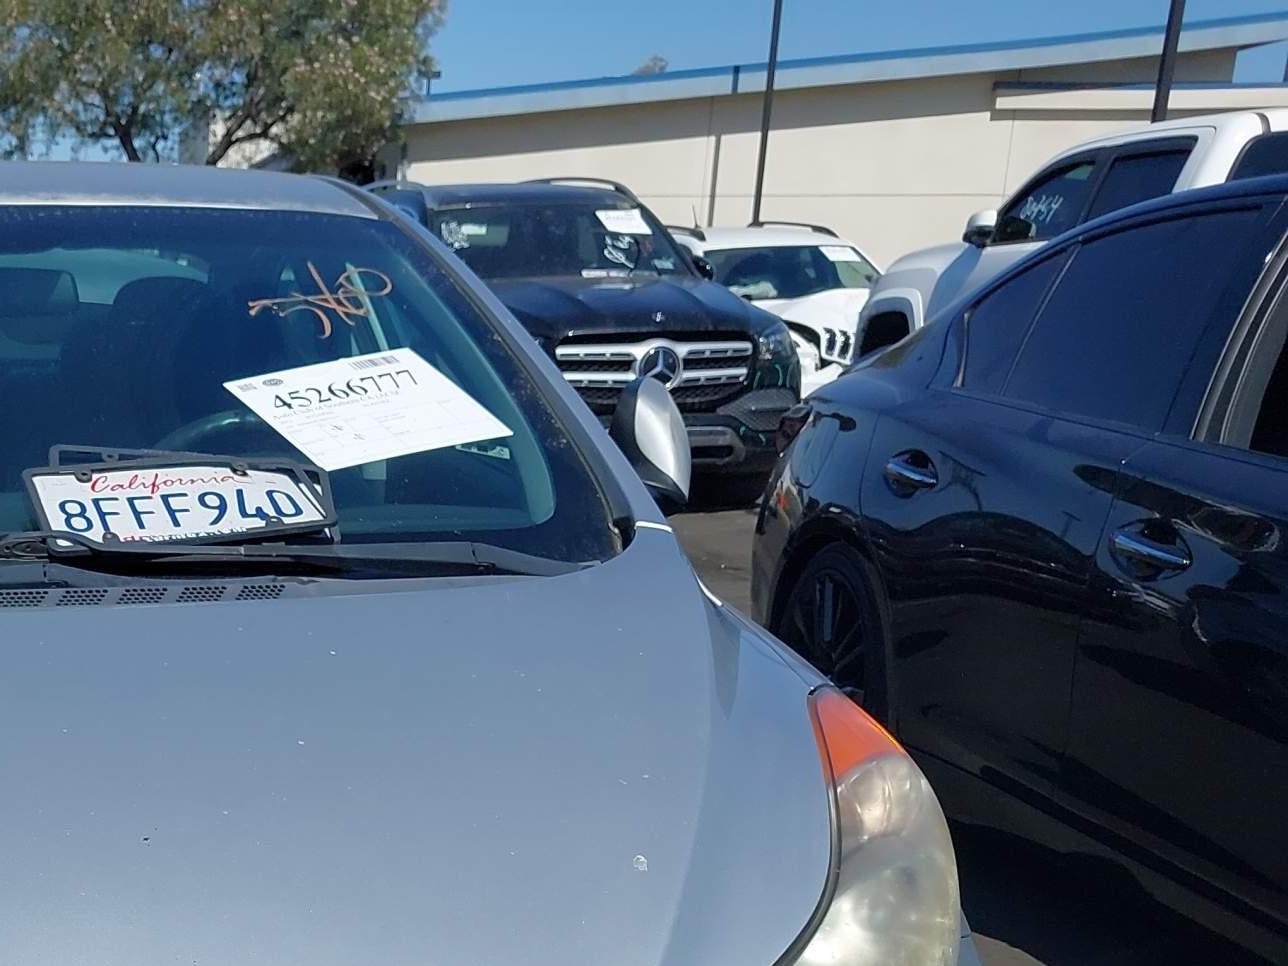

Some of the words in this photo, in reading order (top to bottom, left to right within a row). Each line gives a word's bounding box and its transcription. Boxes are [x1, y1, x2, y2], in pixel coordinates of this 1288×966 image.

[274, 369, 418, 410] 45266777
[91, 472, 241, 495] California
[58, 488, 304, 537] 8FFF940
